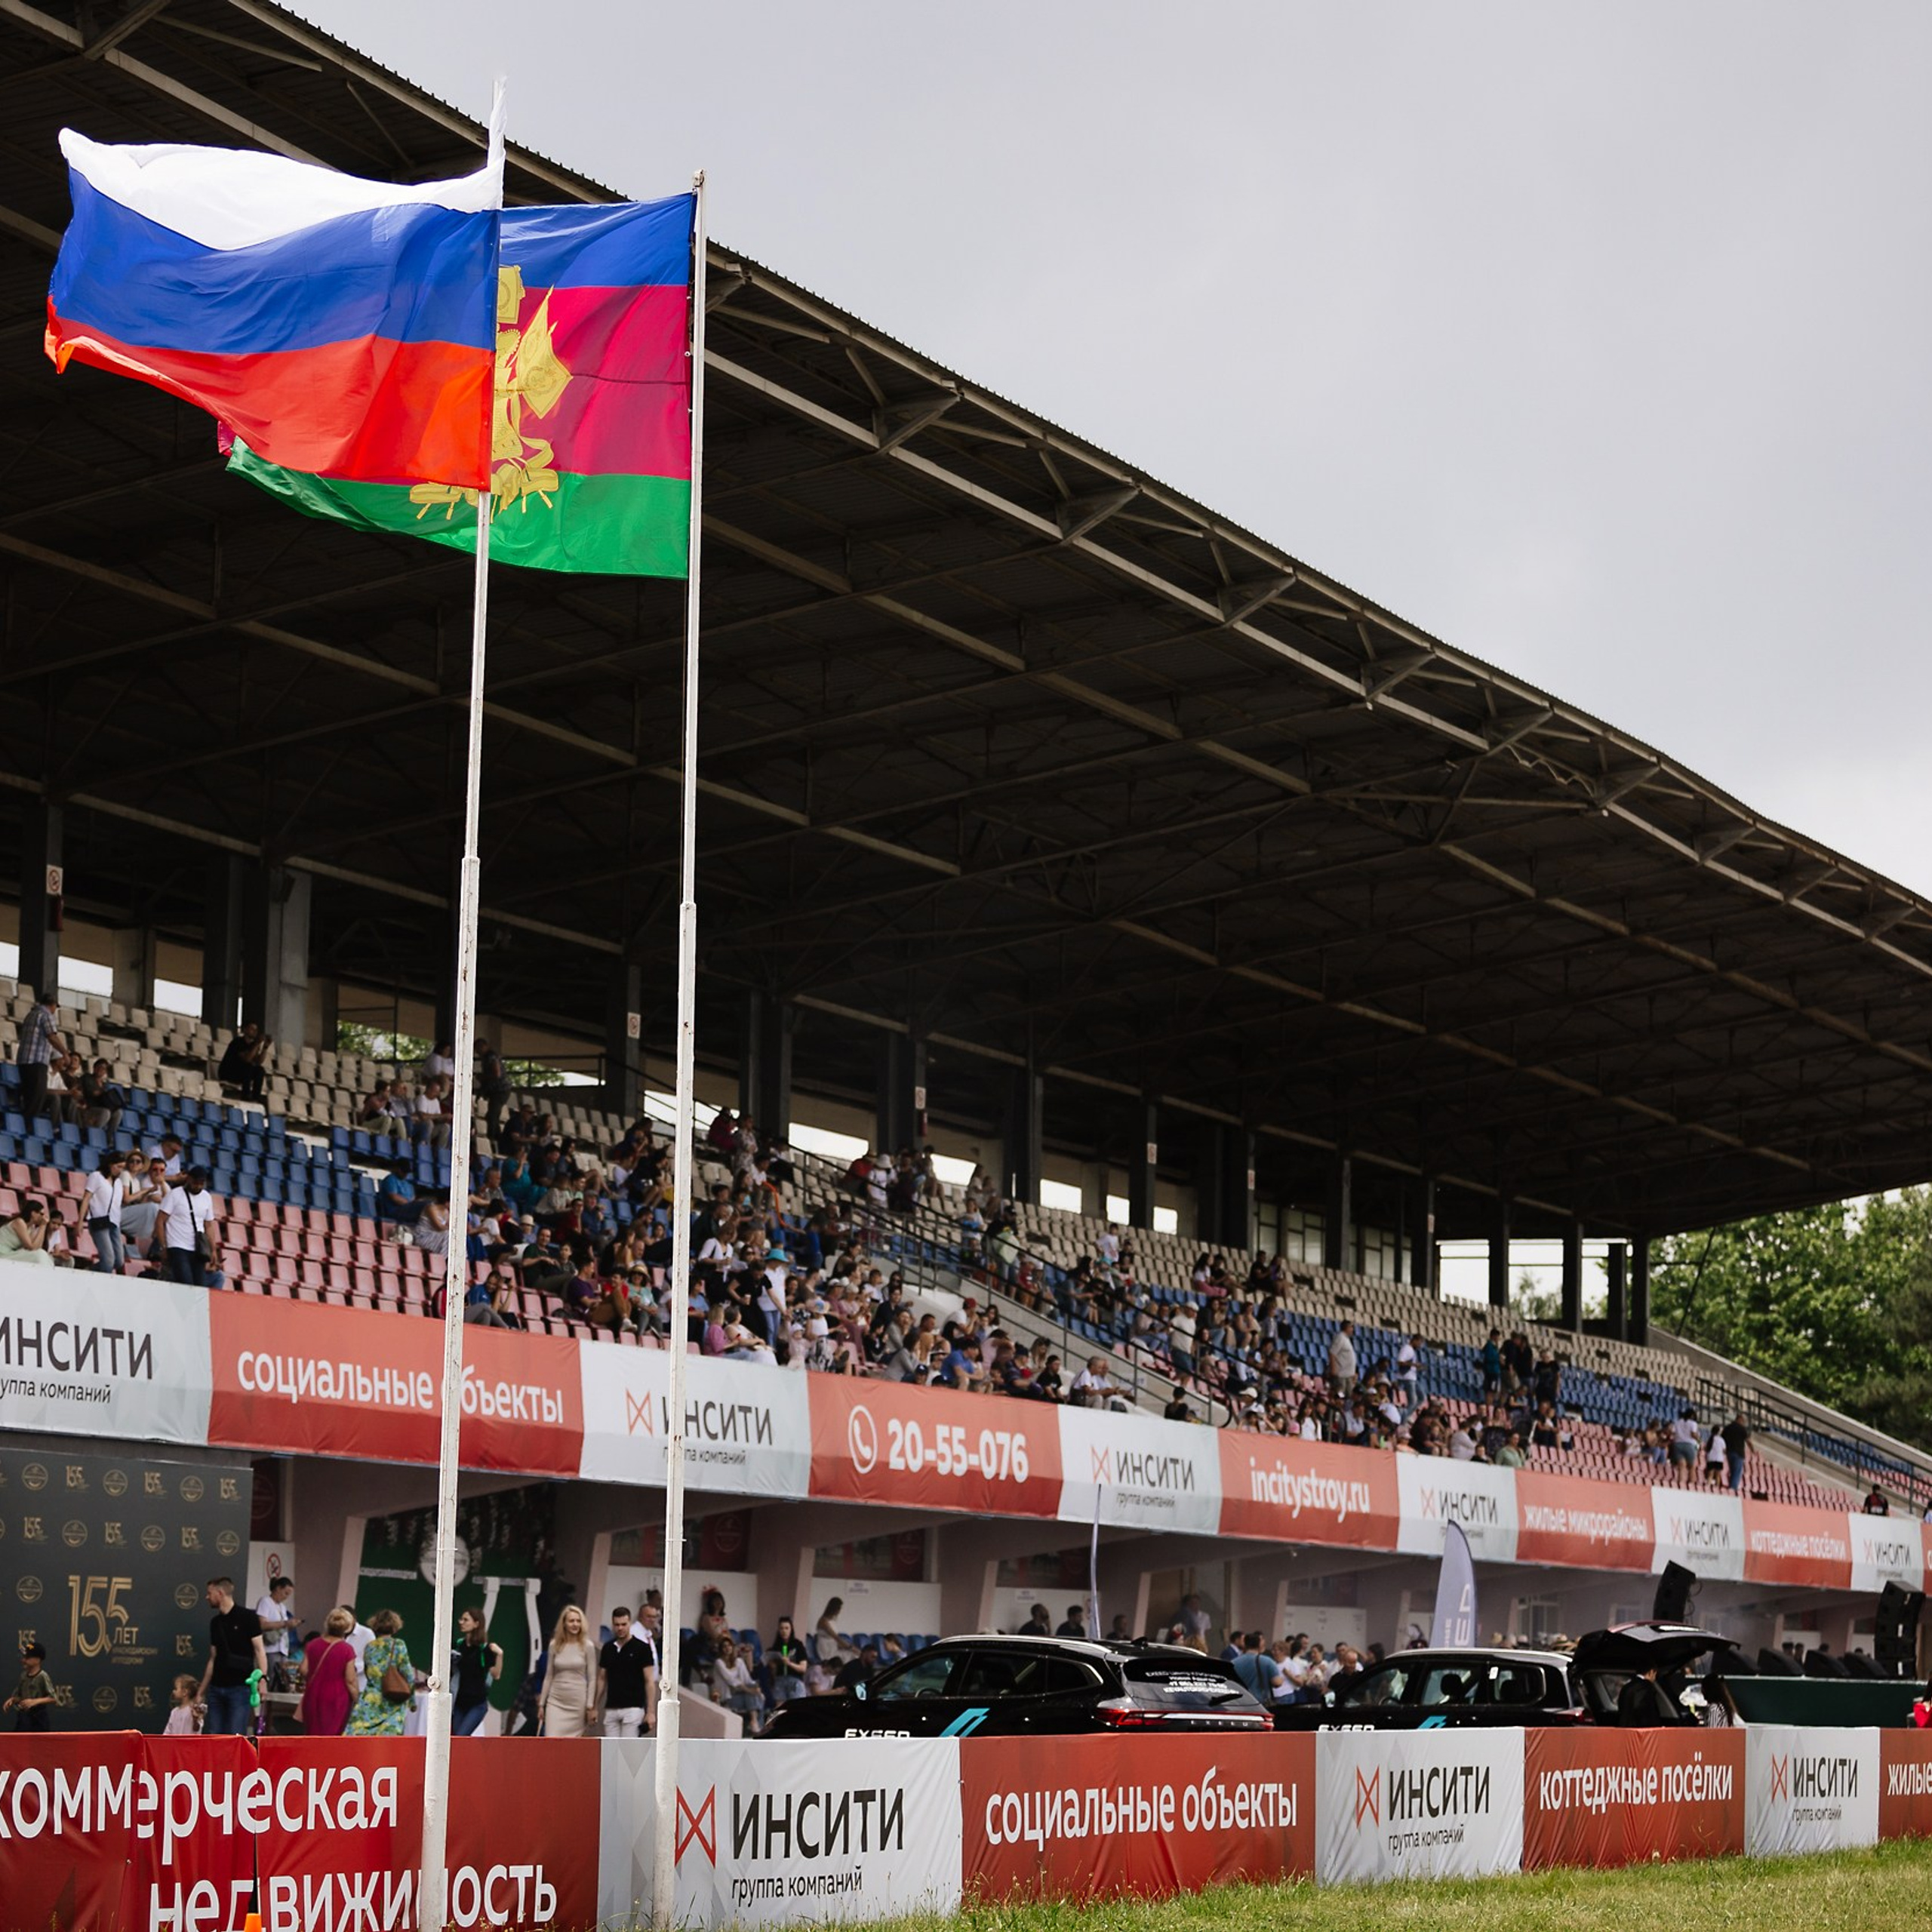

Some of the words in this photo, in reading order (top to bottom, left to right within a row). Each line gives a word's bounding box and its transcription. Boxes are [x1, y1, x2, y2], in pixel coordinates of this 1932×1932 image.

[0, 1378, 35, 1399] уппа
[40, 1382, 111, 1404] компаний
[238, 1351, 433, 1409] социальные
[441, 1364, 564, 1423] бъекты
[888, 1418, 1029, 1483] 20-55-076
[1116, 1451, 1195, 1492] ИНСИТИ
[1250, 1456, 1371, 1523] incitystroy.ru
[1438, 1491, 1498, 1524] ИНСИТИ
[1684, 1519, 1730, 1548] ИНСИТИ
[69, 1575, 132, 1657] 155
[113, 1626, 139, 1644] ЛЕТ
[1389, 1766, 1490, 1821] ИНСИТИ
[1540, 1766, 1657, 1815] коттеджные
[1662, 1752, 1733, 1803] посёлки
[1793, 1757, 1858, 1798] ИНСИТИ
[1887, 1762, 1932, 1796] жилые
[733, 1789, 903, 1860] ИНСИТИ
[986, 1784, 1175, 1851] социальные
[1182, 1765, 1297, 1832] объекты
[1388, 1832, 1420, 1857] группа
[1421, 1823, 1464, 1846] компаний
[150, 1864, 558, 1932] недвижиость
[731, 1876, 783, 1907] группа
[789, 1865, 862, 1897] компаний
